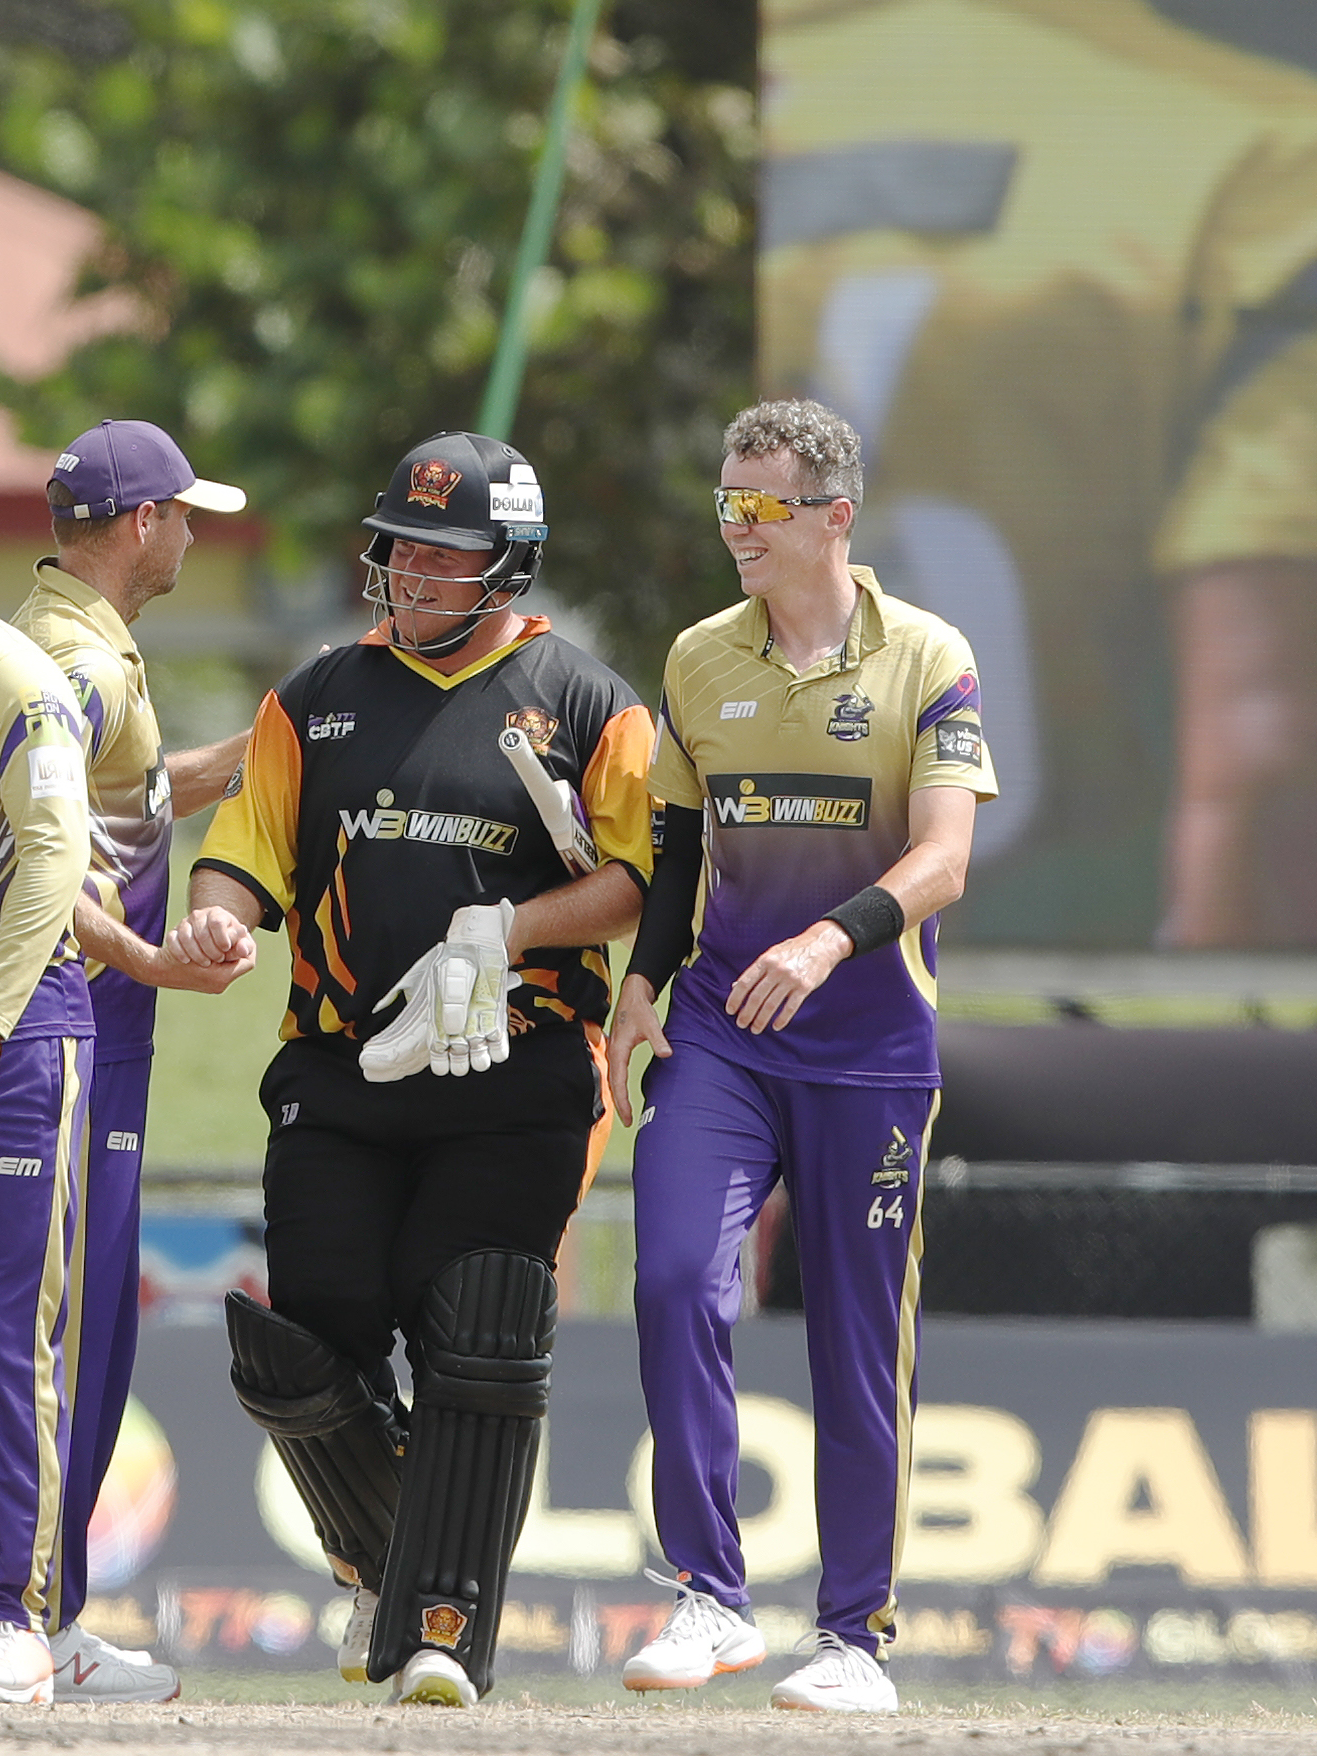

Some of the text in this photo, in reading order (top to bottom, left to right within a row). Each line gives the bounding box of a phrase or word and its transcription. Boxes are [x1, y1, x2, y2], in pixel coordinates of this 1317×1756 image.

[55, 453, 80, 472] EM
[720, 701, 759, 720] EM
[774, 798, 862, 824] WINBUZZ
[407, 812, 515, 852] WINBUZZ
[106, 1130, 139, 1151] EM
[867, 1195, 904, 1229] 64
